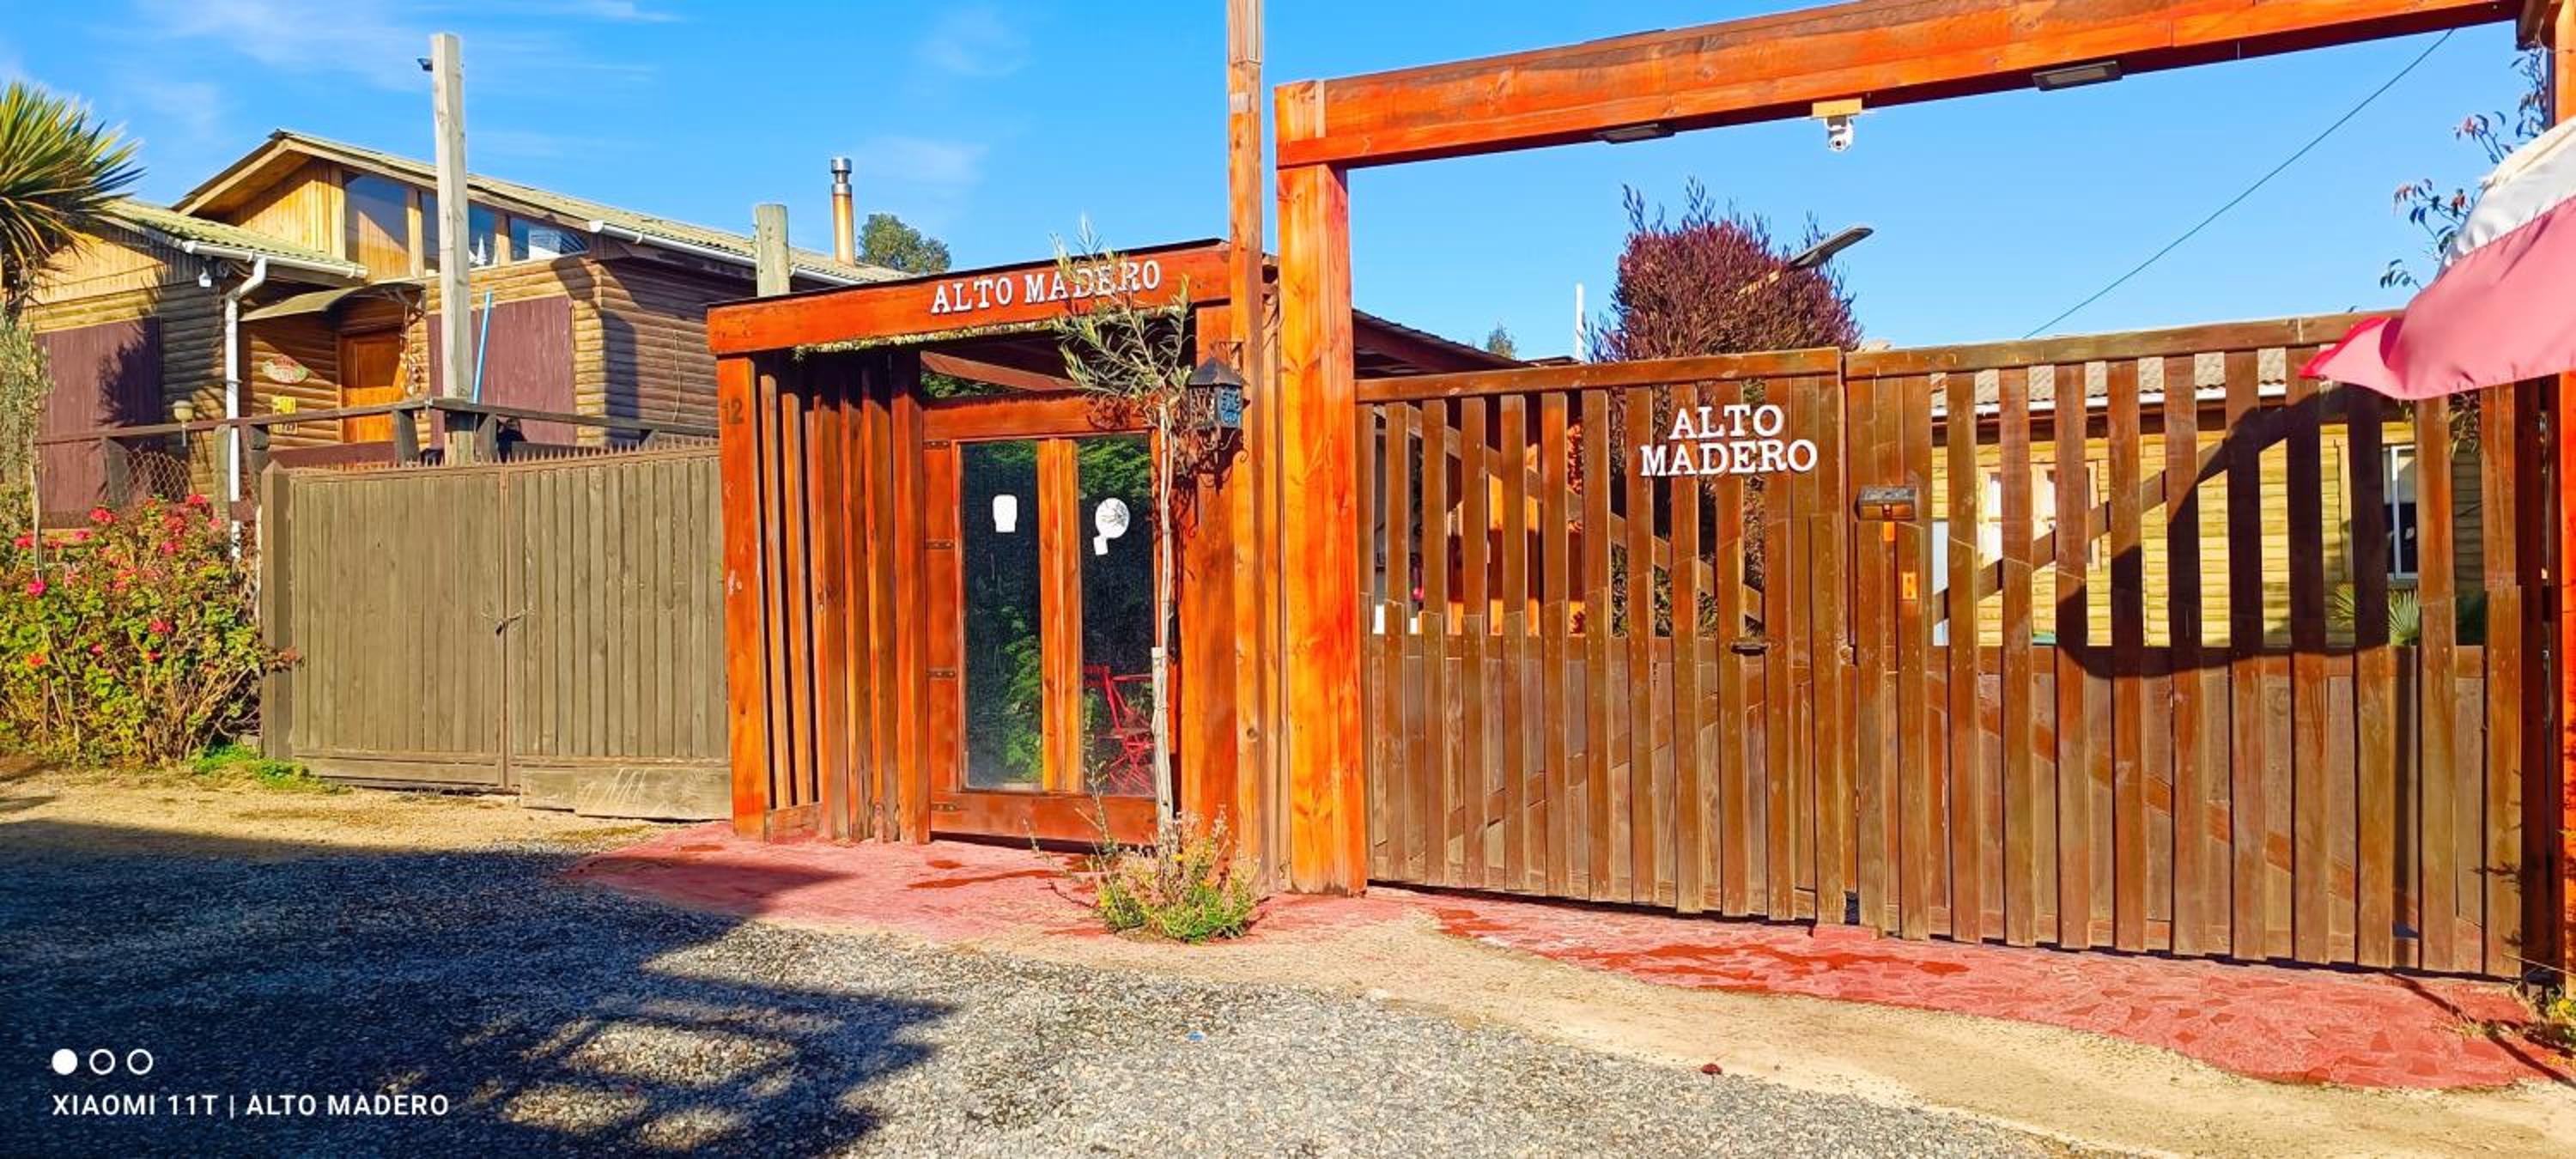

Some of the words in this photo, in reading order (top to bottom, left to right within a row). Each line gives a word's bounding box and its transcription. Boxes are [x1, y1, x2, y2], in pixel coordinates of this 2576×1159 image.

[931, 277, 1012, 313] ALTO
[1024, 260, 1160, 303] MADERO
[1668, 404, 1785, 440] ALTO
[1641, 439, 1818, 476] MADERO
